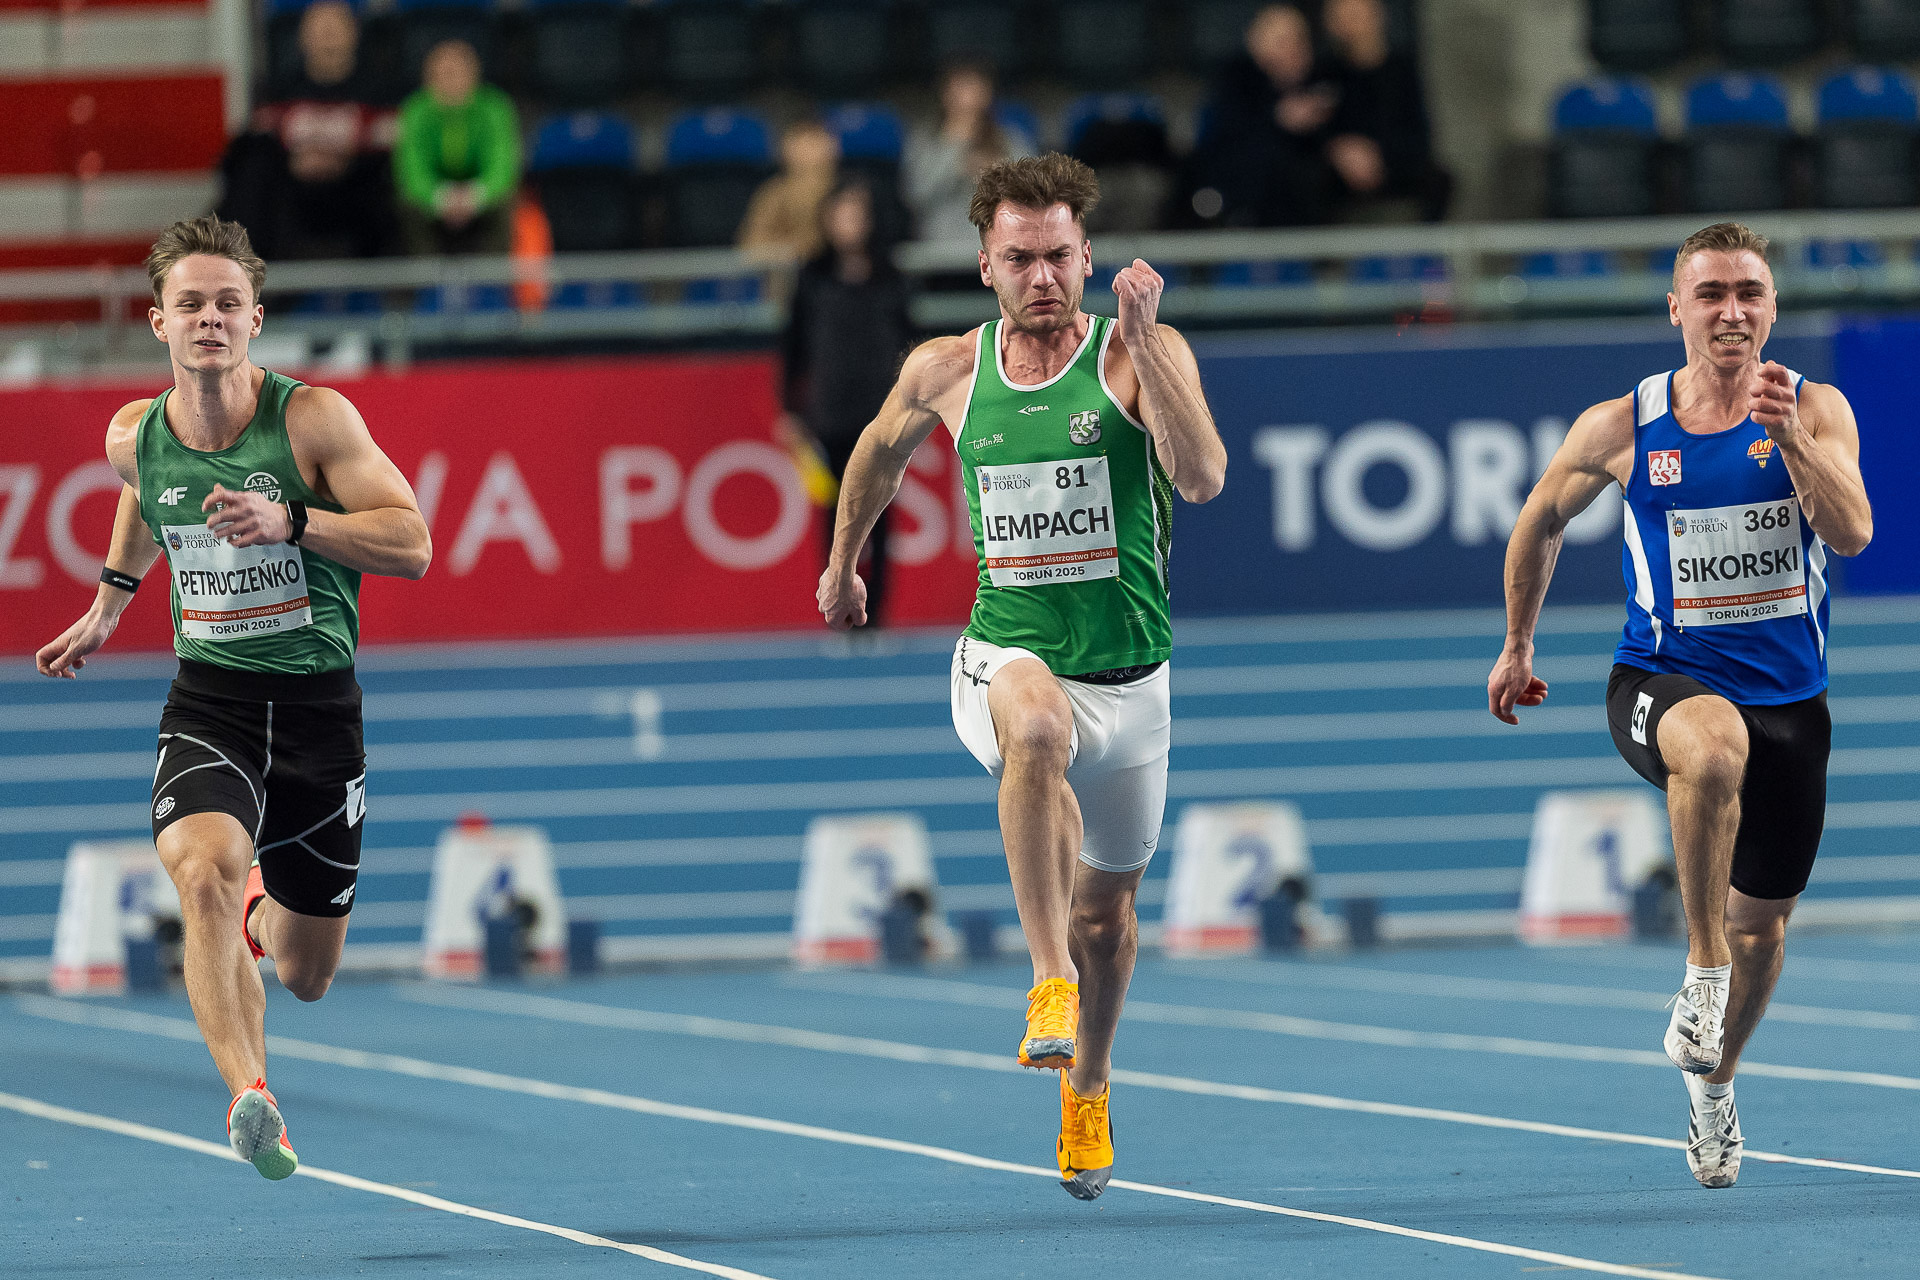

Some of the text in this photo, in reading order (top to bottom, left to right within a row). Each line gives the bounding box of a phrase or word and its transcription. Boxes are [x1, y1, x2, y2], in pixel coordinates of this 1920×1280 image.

[251, 477, 271, 487] AZS
[993, 473, 1022, 481] MIASTO
[993, 475, 1031, 491] TORUŃ
[1055, 464, 1089, 490] 81
[158, 486, 189, 506] 4F
[985, 505, 1110, 541] LEMPACH
[1690, 519, 1728, 534] TORUŃ
[1743, 505, 1791, 533] 368
[184, 532, 212, 540] MIASTO
[999, 558, 1015, 567] PZLA
[1015, 557, 1042, 566] Halowe
[1042, 553, 1089, 564] Mistrzostwa
[1090, 549, 1113, 558] Polski
[1677, 546, 1799, 583] SIKORSKI
[179, 558, 300, 596] PETRUCZEŃKO
[1014, 566, 1085, 580] TORUŃ 2025
[1680, 587, 1803, 607] 69. PZLA Halowe Mistrzostwa Polski
[211, 611, 237, 620] Halowe
[238, 605, 283, 619] Mistrzostwa
[284, 599, 306, 610] Polski
[1707, 604, 1779, 620] TORUŃ 2025
[209, 618, 281, 635] TORUŃ 2025
[1632, 704, 1646, 733] 5
[331, 882, 356, 906] 4F
